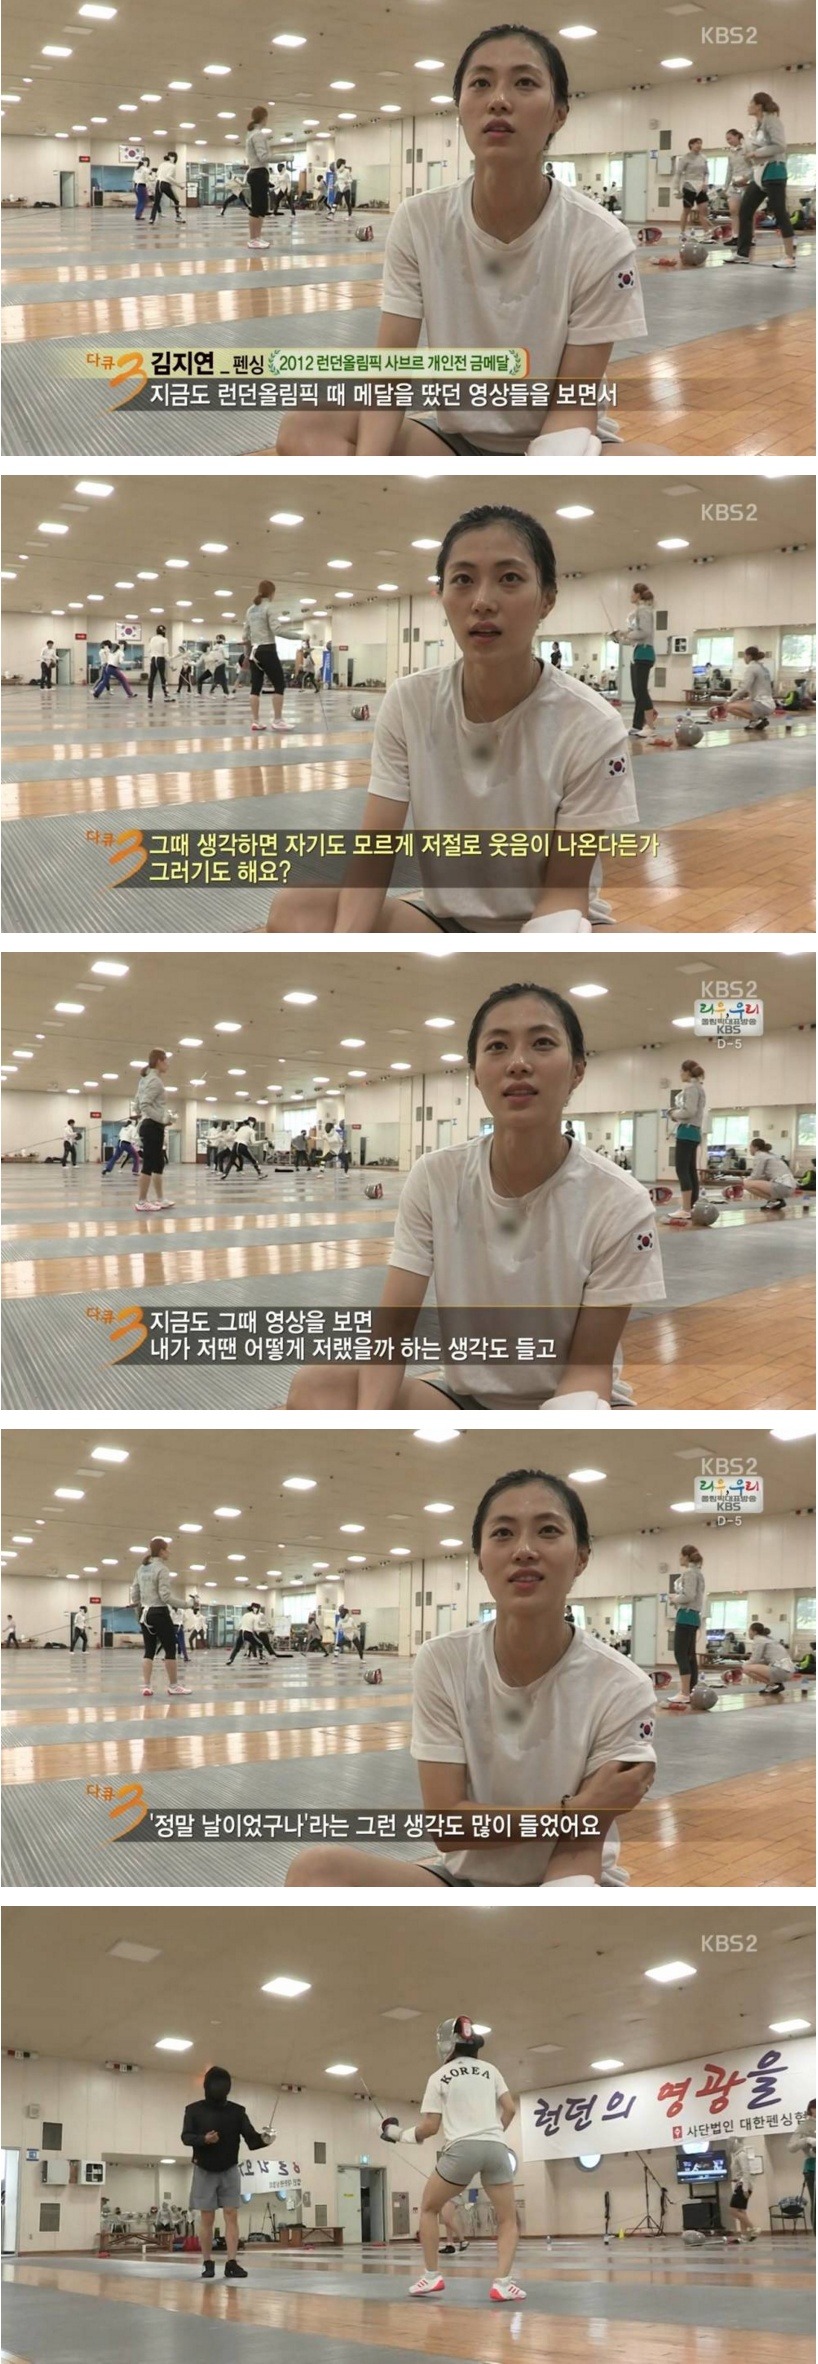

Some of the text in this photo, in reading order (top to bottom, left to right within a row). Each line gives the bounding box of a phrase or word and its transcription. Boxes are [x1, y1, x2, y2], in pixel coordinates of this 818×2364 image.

[440, 2066, 491, 2085] KOREA
[534, 2050, 789, 2137] 런던의 영광을
[687, 2119, 734, 2138] 사단법인
